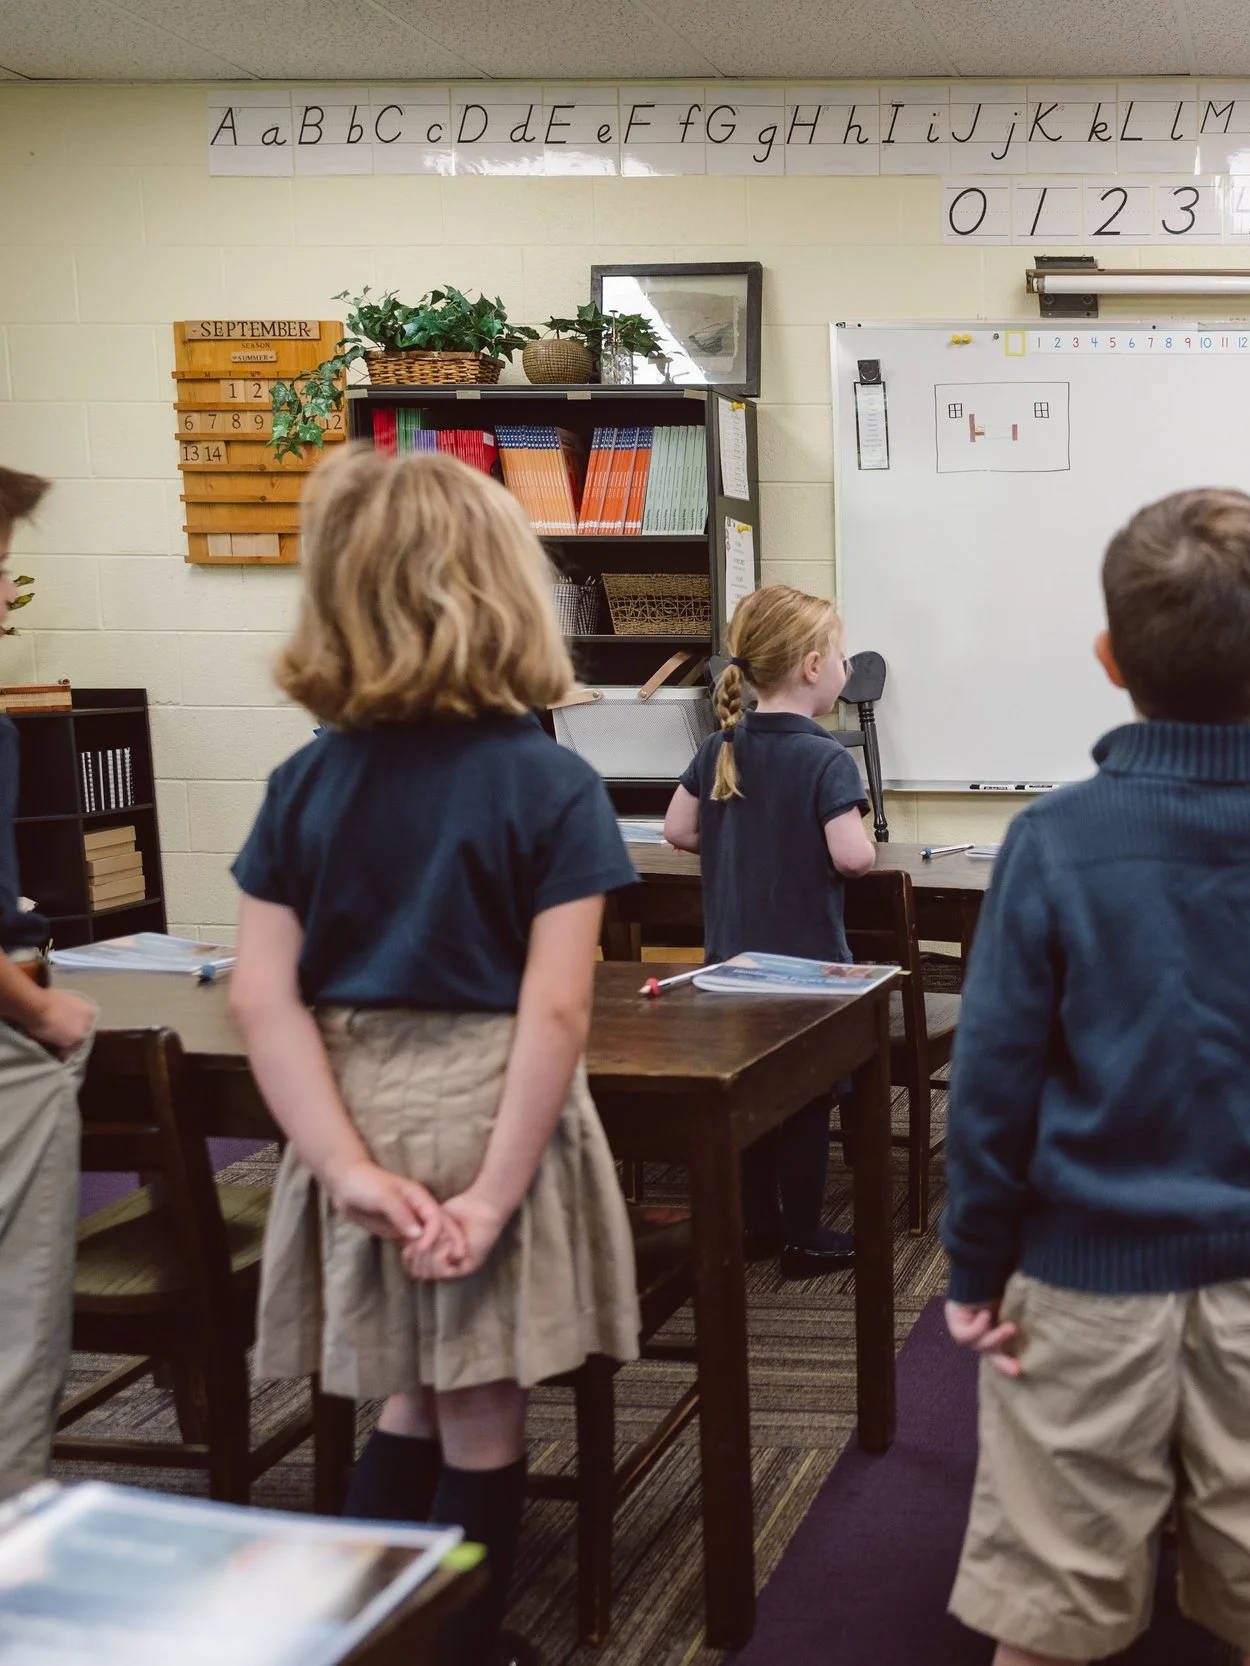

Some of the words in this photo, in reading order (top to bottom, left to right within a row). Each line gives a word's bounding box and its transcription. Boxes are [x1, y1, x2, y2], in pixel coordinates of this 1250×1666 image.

[948, 187, 987, 236] 0
[1029, 187, 1048, 237] 1
[1092, 187, 1128, 236] 2
[1161, 186, 1200, 235] 3
[200, 321, 311, 338] SEPTEMBER
[1053, 336, 1061, 349] 2
[1072, 336, 1080, 349] 3
[1090, 337, 1099, 349] 4
[1109, 336, 1117, 349] 5
[1128, 337, 1136, 349] 6
[1147, 337, 1154, 349] 7
[1165, 336, 1173, 349] 8
[1184, 337, 1192, 349] 9
[1200, 337, 1212, 349] 10
[1221, 336, 1229, 348] 11
[1238, 336, 1248, 349] 12
[229, 383, 237, 398] 1
[253, 382, 263, 398] 2
[184, 415, 194, 431] 6
[208, 414, 217, 429] 7
[231, 413, 241, 429] 8
[254, 414, 264, 430] 9
[183, 445, 200, 461] 13
[204, 446, 222, 462] 14
